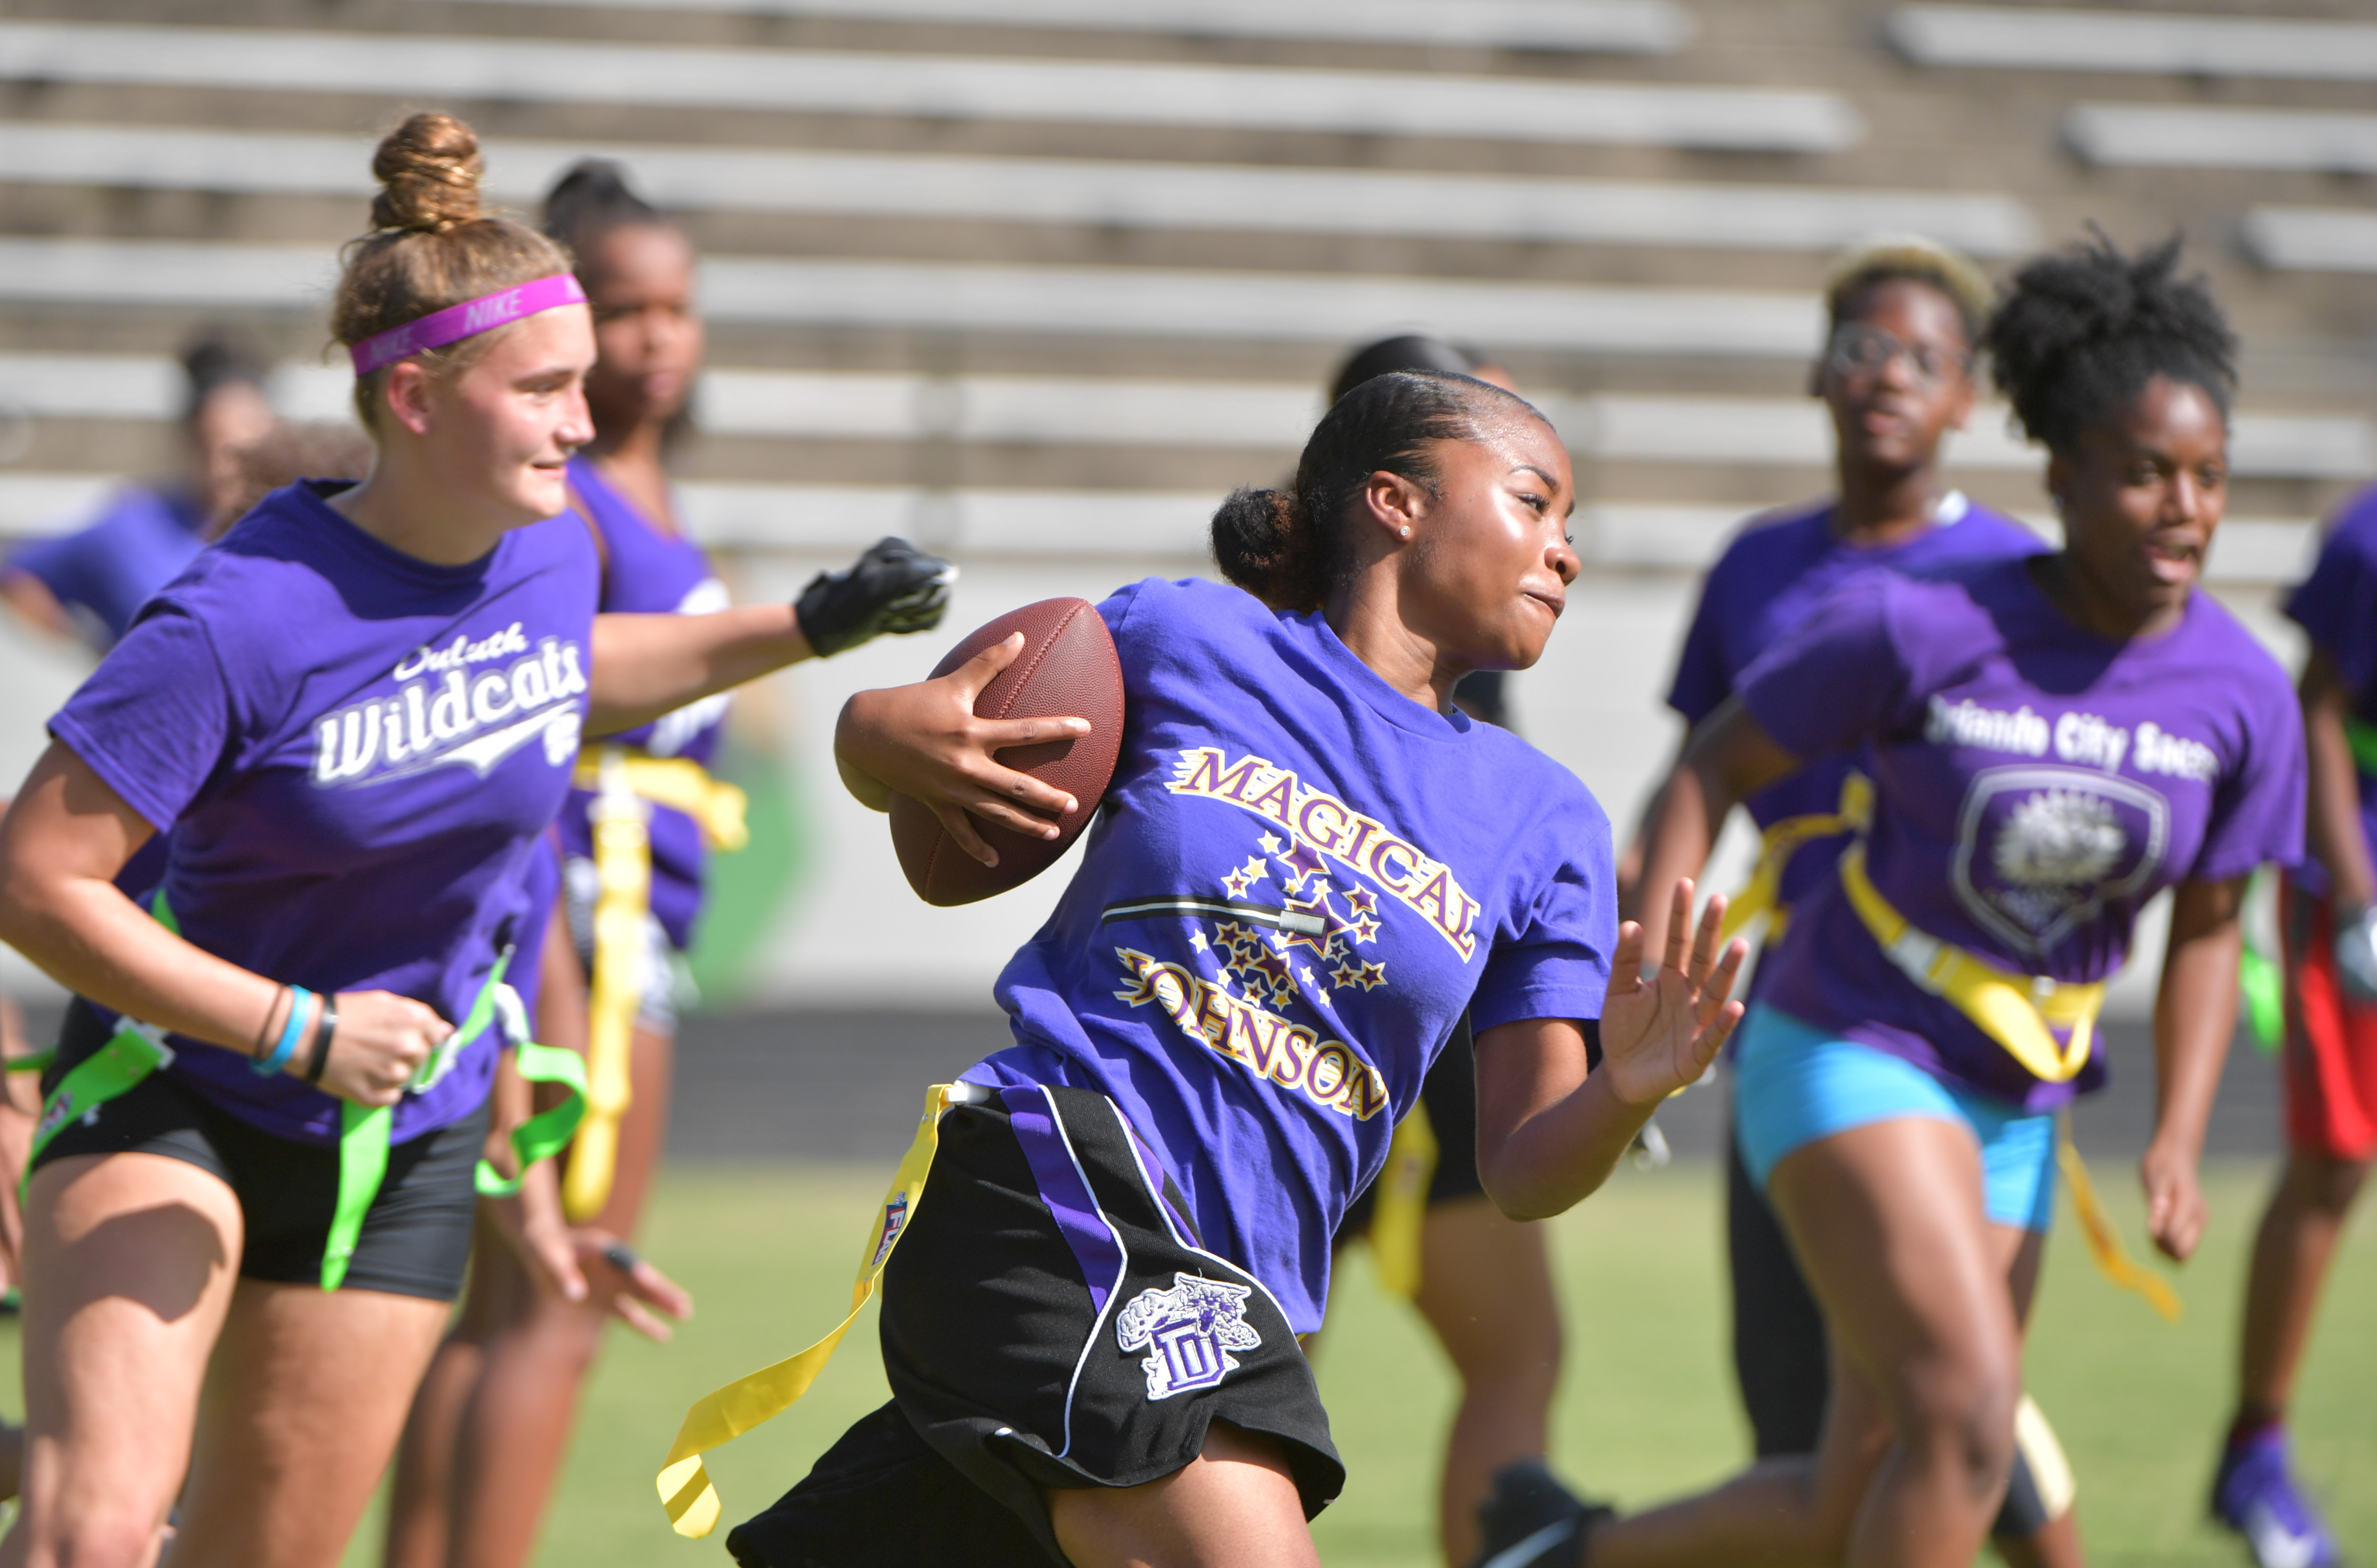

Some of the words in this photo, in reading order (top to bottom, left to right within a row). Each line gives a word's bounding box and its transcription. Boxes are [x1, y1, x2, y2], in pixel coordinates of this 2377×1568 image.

[463, 288, 524, 333] NIKE
[312, 636, 587, 787] Wildcats
[2055, 711, 2129, 776] City
[1165, 747, 1480, 964] MAGICAL
[1112, 946, 1389, 1121] JOHNSON
[873, 1207, 907, 1264] FLAG
